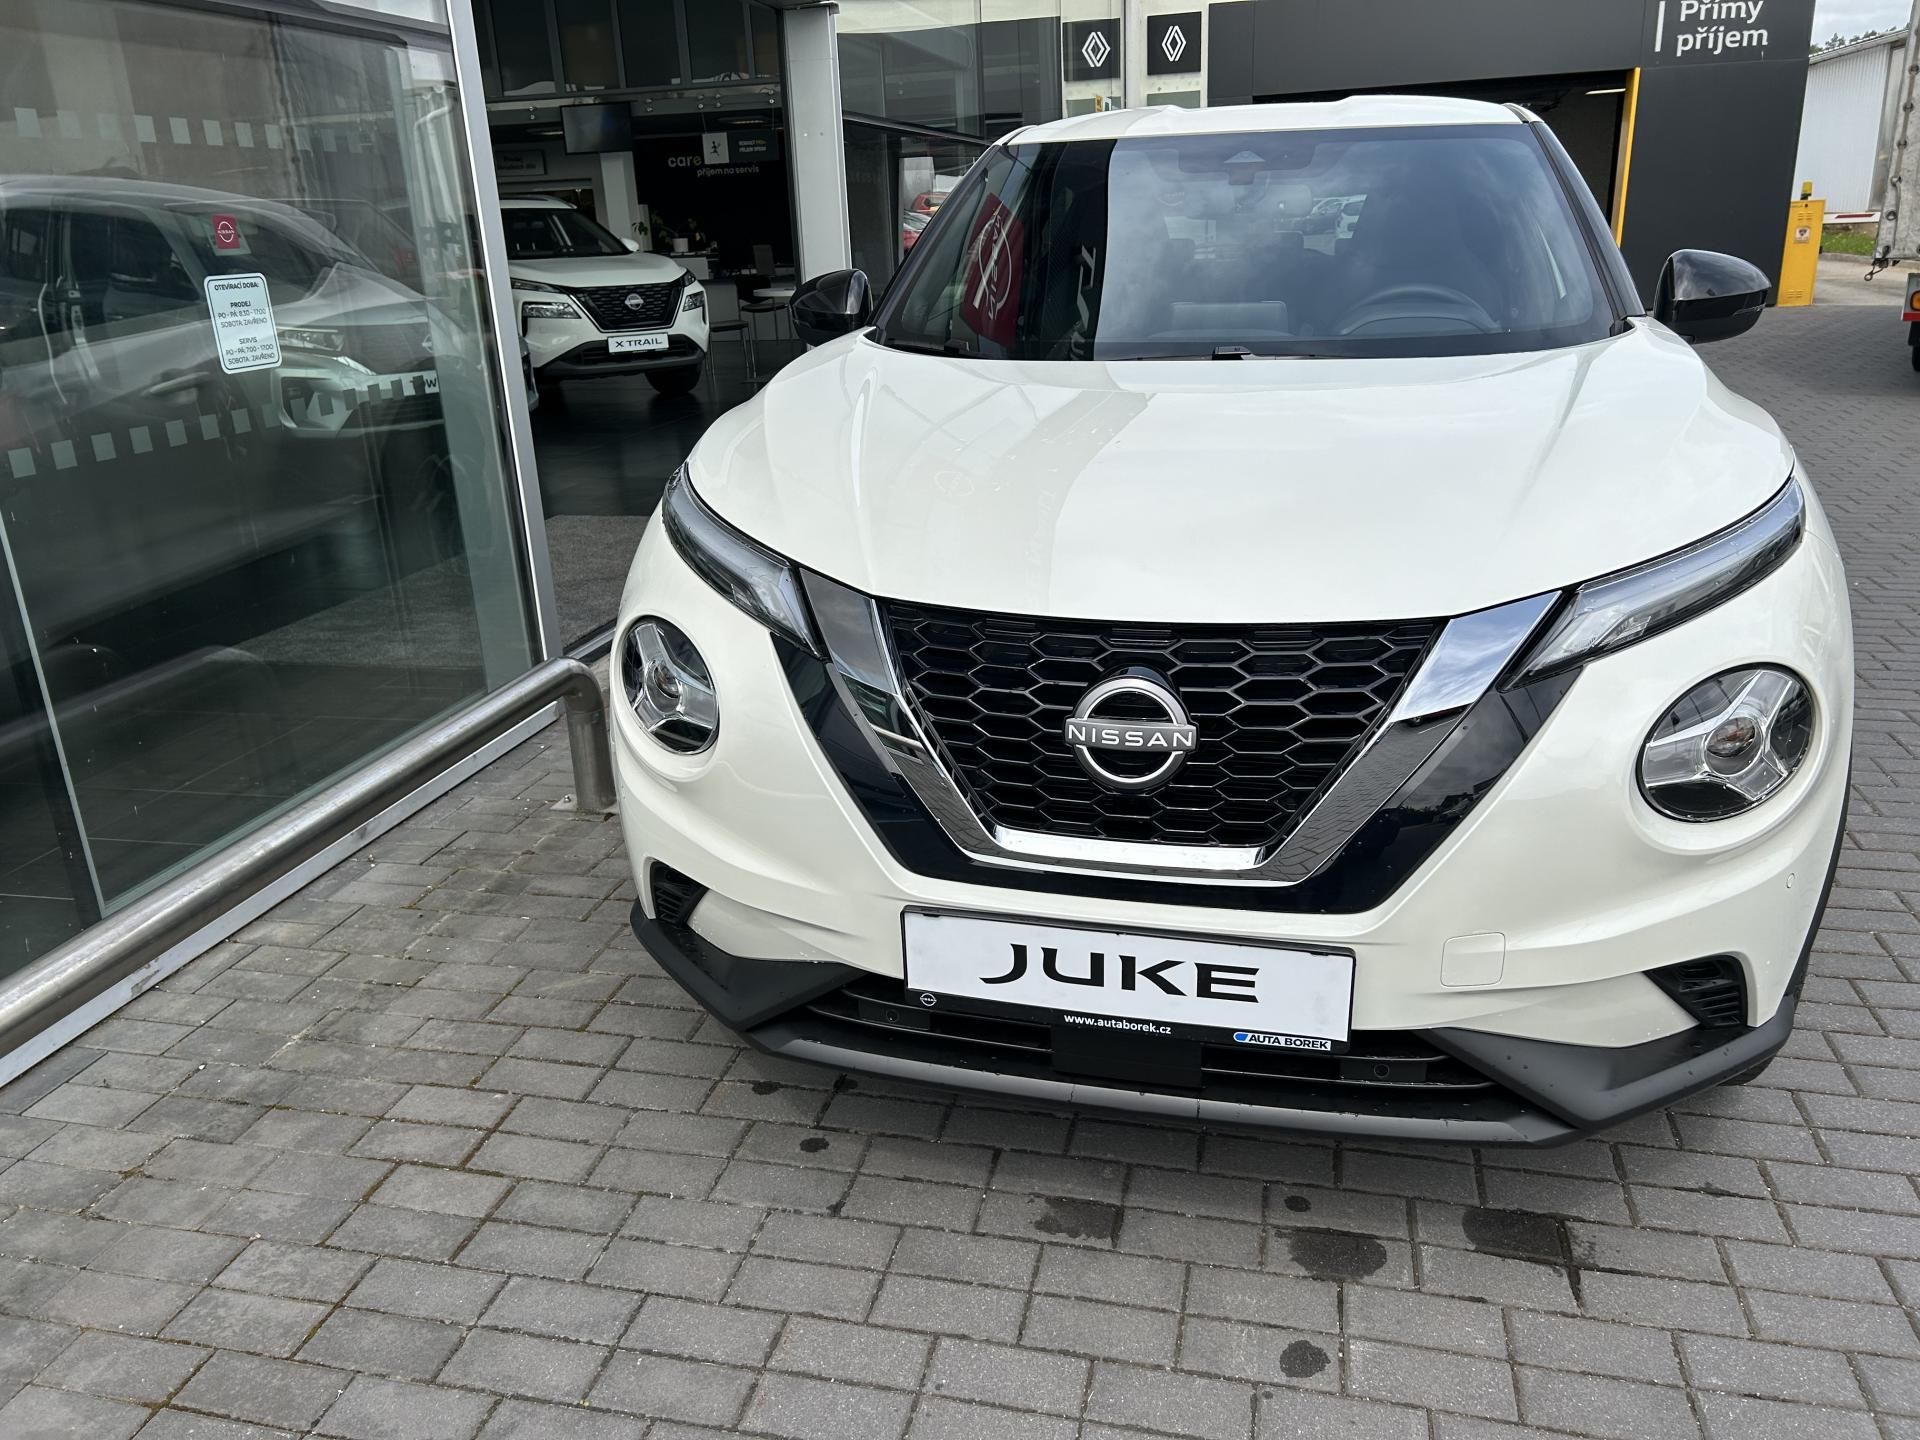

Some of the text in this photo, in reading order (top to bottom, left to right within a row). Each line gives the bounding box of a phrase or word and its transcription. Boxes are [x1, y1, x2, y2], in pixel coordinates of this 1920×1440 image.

[1676, 25, 1768, 57] příjem
[667, 156, 702, 168] care
[230, 300, 251, 308] PRODEJ
[239, 336, 258, 344] SERVIS
[626, 338, 663, 347] TRAIL
[1068, 724, 1193, 747] NISSAN
[978, 943, 1260, 1003] JUKE
[1064, 1014, 1172, 1034] www.autaborek.cz
[1249, 1034, 1329, 1049] AUTA BOREK
